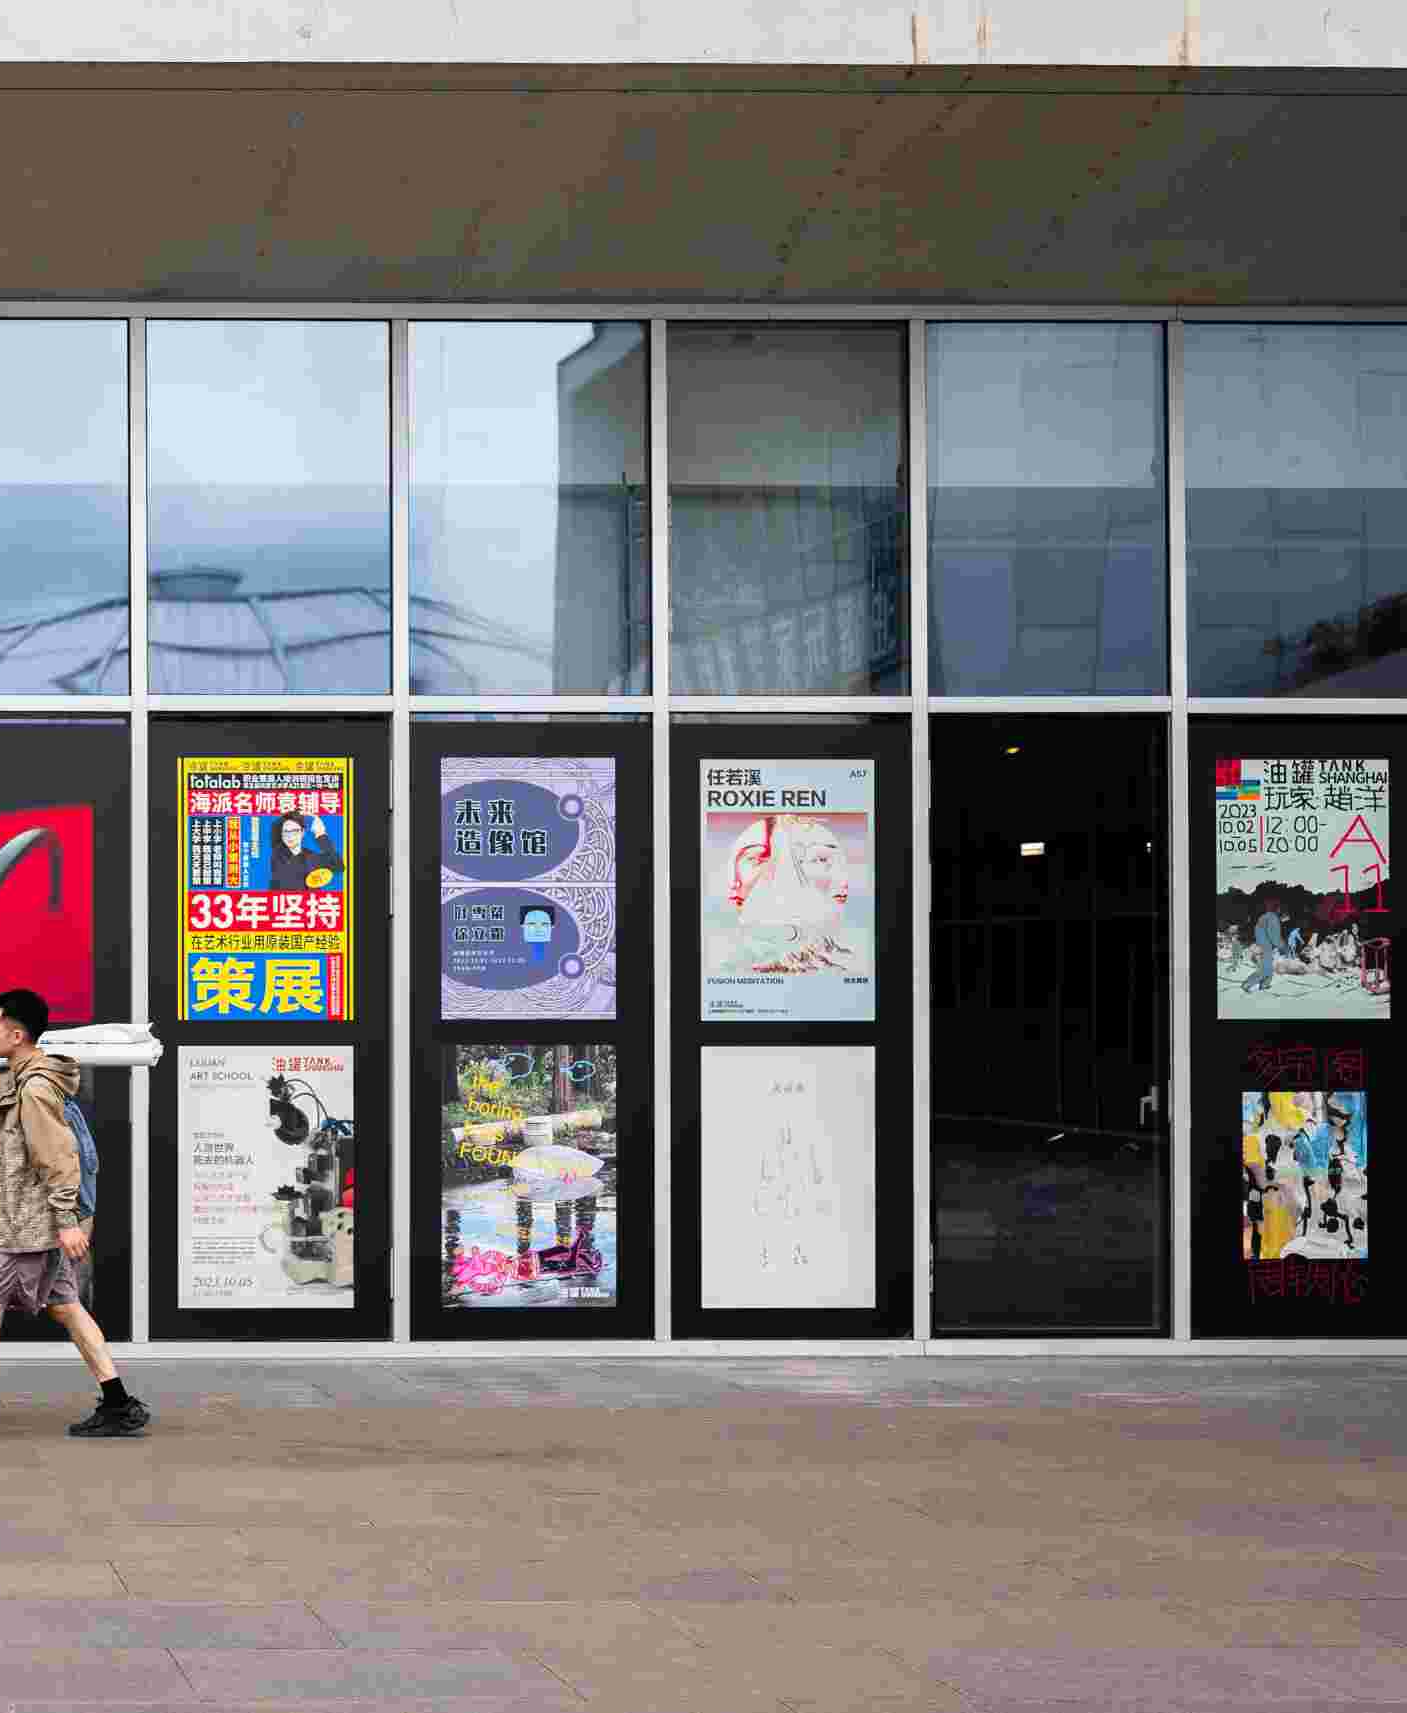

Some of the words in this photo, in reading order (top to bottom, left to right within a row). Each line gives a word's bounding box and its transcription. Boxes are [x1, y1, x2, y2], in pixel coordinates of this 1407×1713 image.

[1264, 761, 1315, 784] 油罐
[1319, 760, 1365, 771] TANK
[192, 775, 241, 789] totalab
[1319, 772, 1388, 784] SHANGHAI
[707, 790, 775, 807] ROXIE
[782, 790, 826, 807] REN
[1265, 788, 1316, 810] 玩家
[455, 800, 513, 825] 未来
[1220, 804, 1257, 818] 2023
[455, 830, 548, 856] 造像馆
[1330, 815, 1387, 864] A
[192, 894, 340, 929] 33年坚持
[192, 957, 323, 1014] 策展
[212, 1072, 254, 1081] SCHOOL
